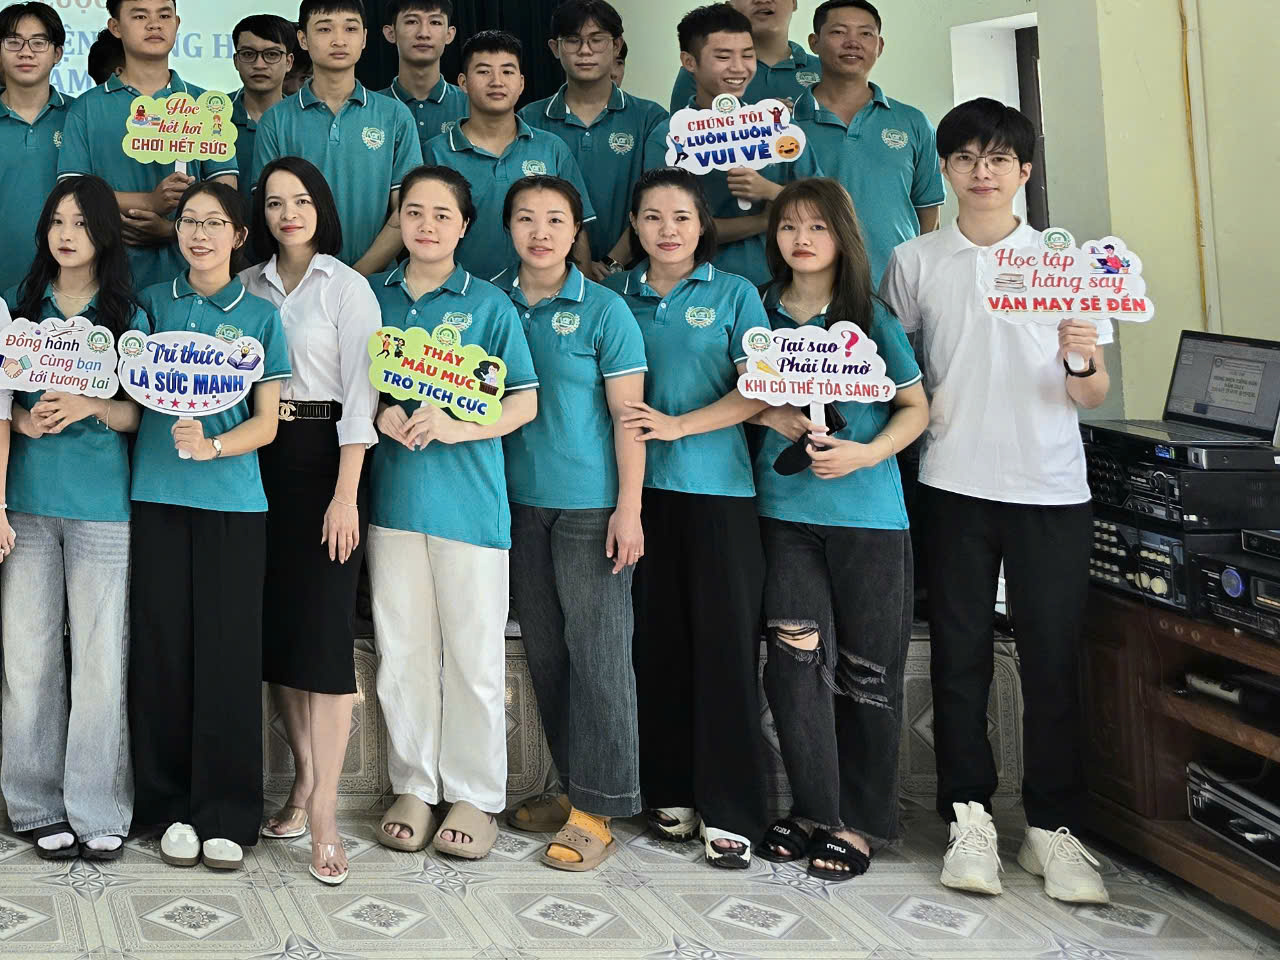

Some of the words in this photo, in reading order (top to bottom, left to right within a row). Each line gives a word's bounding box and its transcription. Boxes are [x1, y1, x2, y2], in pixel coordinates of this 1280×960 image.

[166, 98, 199, 117] Học
[158, 119, 180, 133] hết
[687, 116, 735, 131] CHÚNG
[739, 111, 764, 125] TÔI
[132, 138, 164, 151] CHƠI
[169, 136, 195, 153] HẾT
[200, 140, 227, 155] SỨC
[687, 131, 728, 147] LUÔN
[731, 126, 772, 141] LUÔN
[695, 146, 737, 167] VUI
[740, 139, 772, 161] VẺ
[994, 248, 1038, 269] Học
[1042, 251, 1074, 272] tập
[1031, 269, 1085, 294] hăng
[1088, 276, 1126, 294] say
[988, 294, 1028, 313] VẬN
[1032, 297, 1074, 311] MAY
[1080, 295, 1101, 311] SẼ
[1106, 294, 1146, 312] ĐẾN
[5, 332, 42, 352] Đồng
[45, 337, 80, 352] hành
[773, 336, 805, 355] Tại
[807, 341, 840, 354] sao
[39, 353, 73, 371] Cùng
[77, 357, 102, 373] bạn
[146, 341, 179, 364] Trí
[181, 341, 225, 366] thức
[401, 357, 438, 377] MẪU
[440, 370, 476, 390] MỰC
[777, 356, 819, 373] Phải
[821, 358, 838, 374] lu
[842, 360, 872, 375] mờ
[29, 370, 47, 383] tới
[49, 372, 88, 390] tương
[91, 376, 110, 389] lai
[130, 366, 149, 390] LÀ
[155, 368, 188, 395] SỨC
[193, 374, 244, 399] MẠNH
[745, 380, 767, 393] KHI
[770, 378, 786, 393] CÓ
[789, 377, 815, 394] THỂ
[817, 378, 842, 396] TỎA
[845, 381, 879, 397] SÁNG
[383, 369, 414, 390] TRÒ
[418, 381, 454, 404] TÍCH
[456, 395, 488, 415] CỰC
